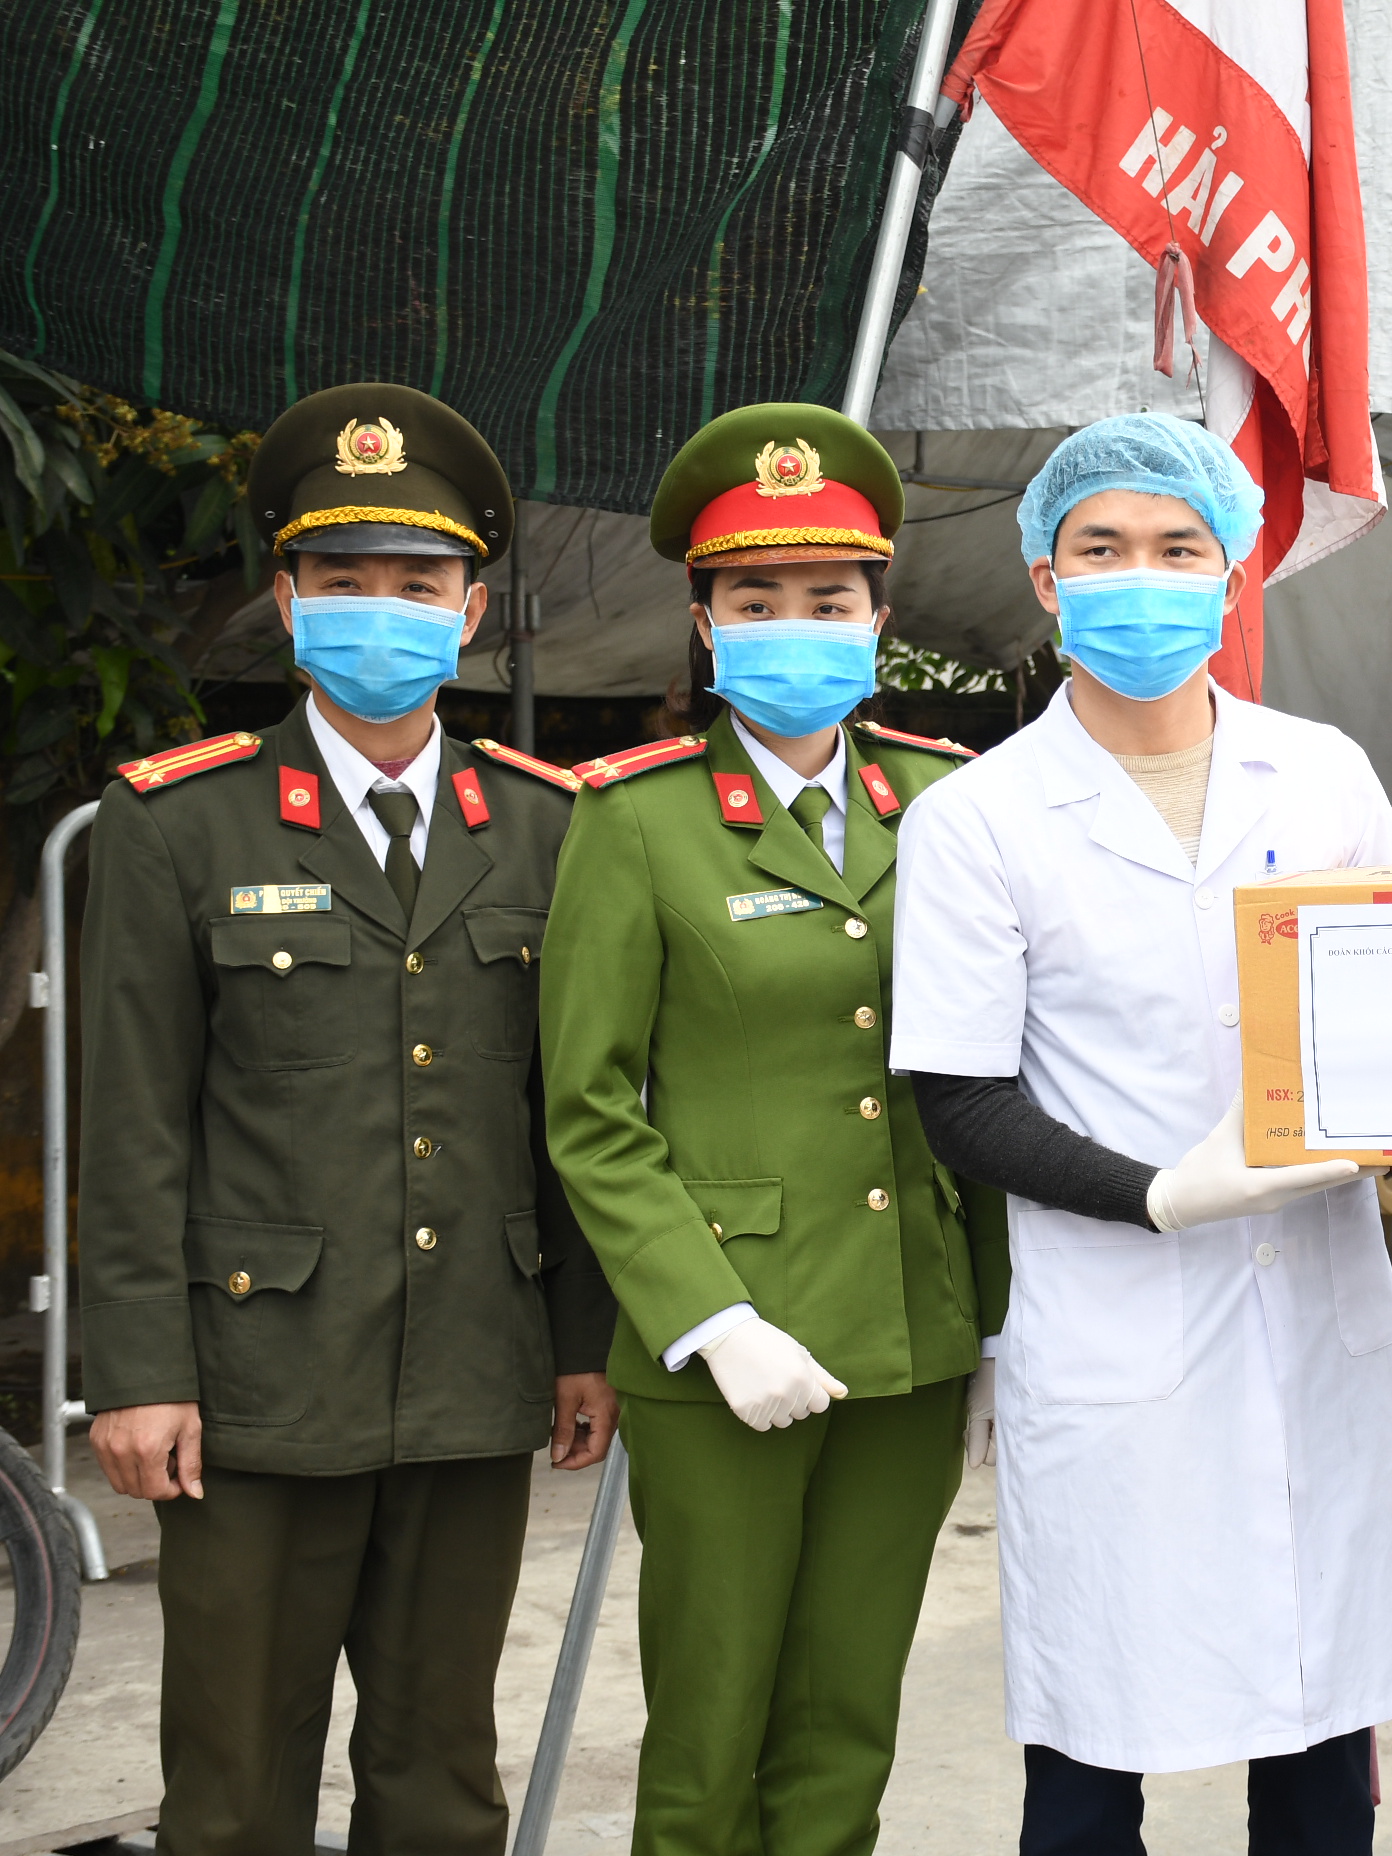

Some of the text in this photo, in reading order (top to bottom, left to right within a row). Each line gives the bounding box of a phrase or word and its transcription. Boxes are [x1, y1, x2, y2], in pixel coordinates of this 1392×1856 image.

[1118, 106, 1311, 372] HẢI PH
[1275, 908, 1295, 921] Cook
[1266, 1088, 1294, 1101] NSX:
[1266, 1127, 1290, 1140] (HSD
